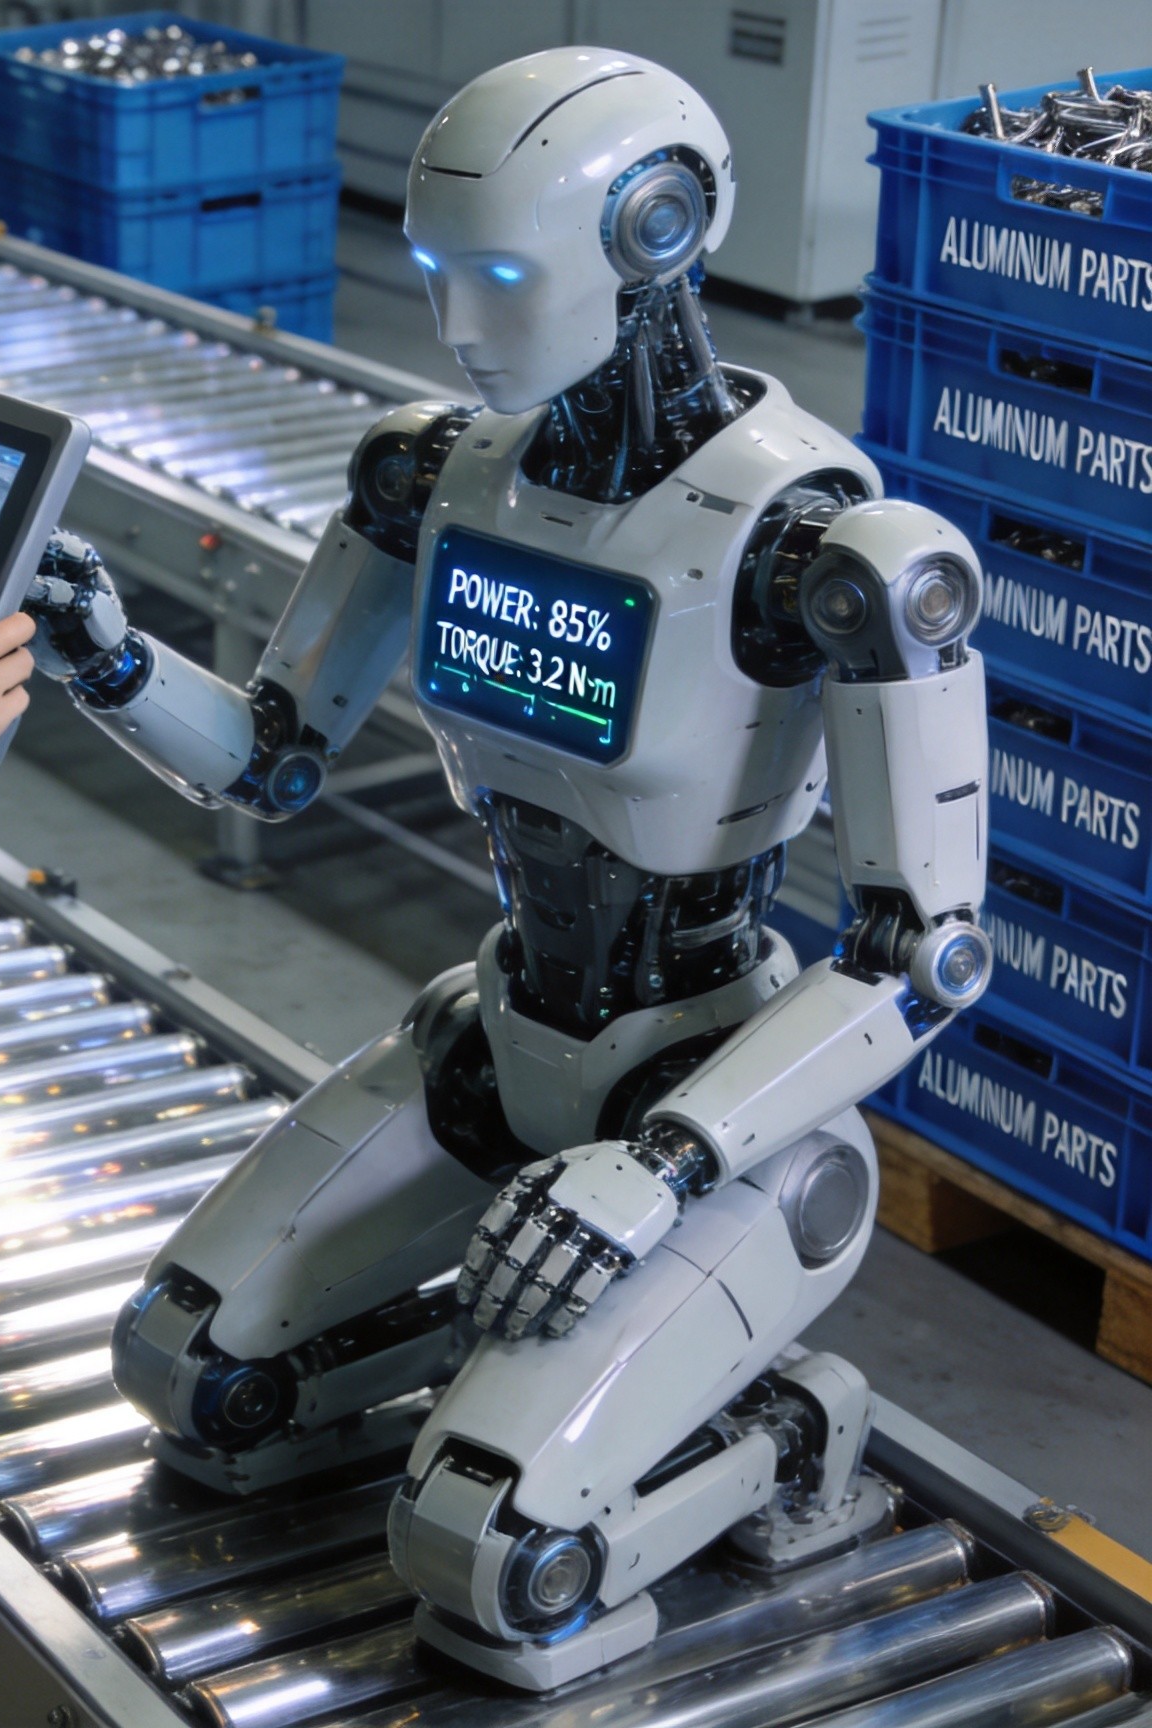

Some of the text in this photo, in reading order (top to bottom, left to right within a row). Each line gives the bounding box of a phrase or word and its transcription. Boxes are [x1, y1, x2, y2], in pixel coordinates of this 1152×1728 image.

[940, 216, 1071, 292] ALUMINUM
[934, 387, 1152, 494] ALUMINUM PARTS
[448, 569, 611, 651] POWER: 85%
[983, 571, 1152, 674] MINUM PARTS
[991, 748, 1141, 850] INUM PARTS
[1050, 943, 1128, 1020] PARTS
[919, 1049, 1118, 1188] ALUMINUM PARTS
